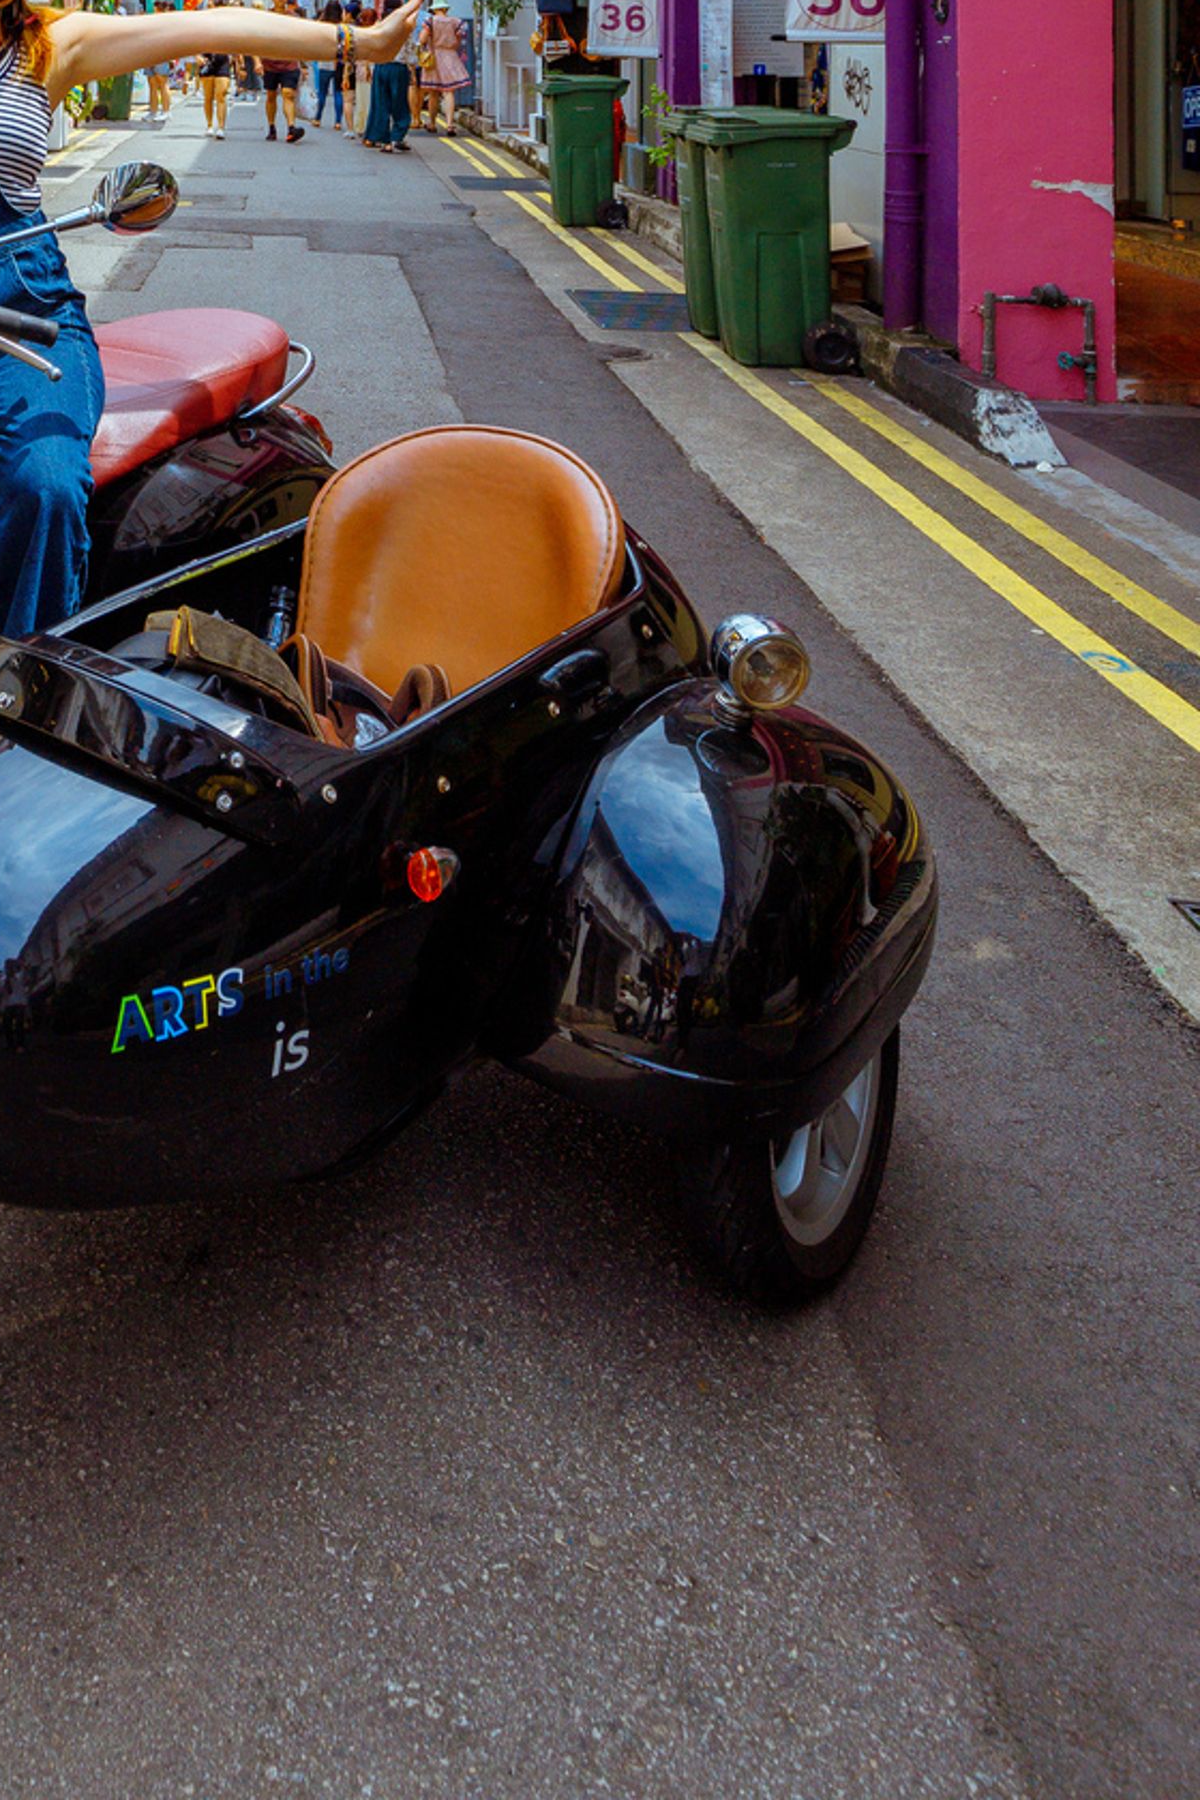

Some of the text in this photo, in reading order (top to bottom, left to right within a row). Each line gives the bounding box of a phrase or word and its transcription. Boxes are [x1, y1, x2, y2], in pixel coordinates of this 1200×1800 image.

[600, 4, 646, 32] 36
[111, 947, 350, 1054] ARTS in the
[271, 1021, 310, 1078] is
